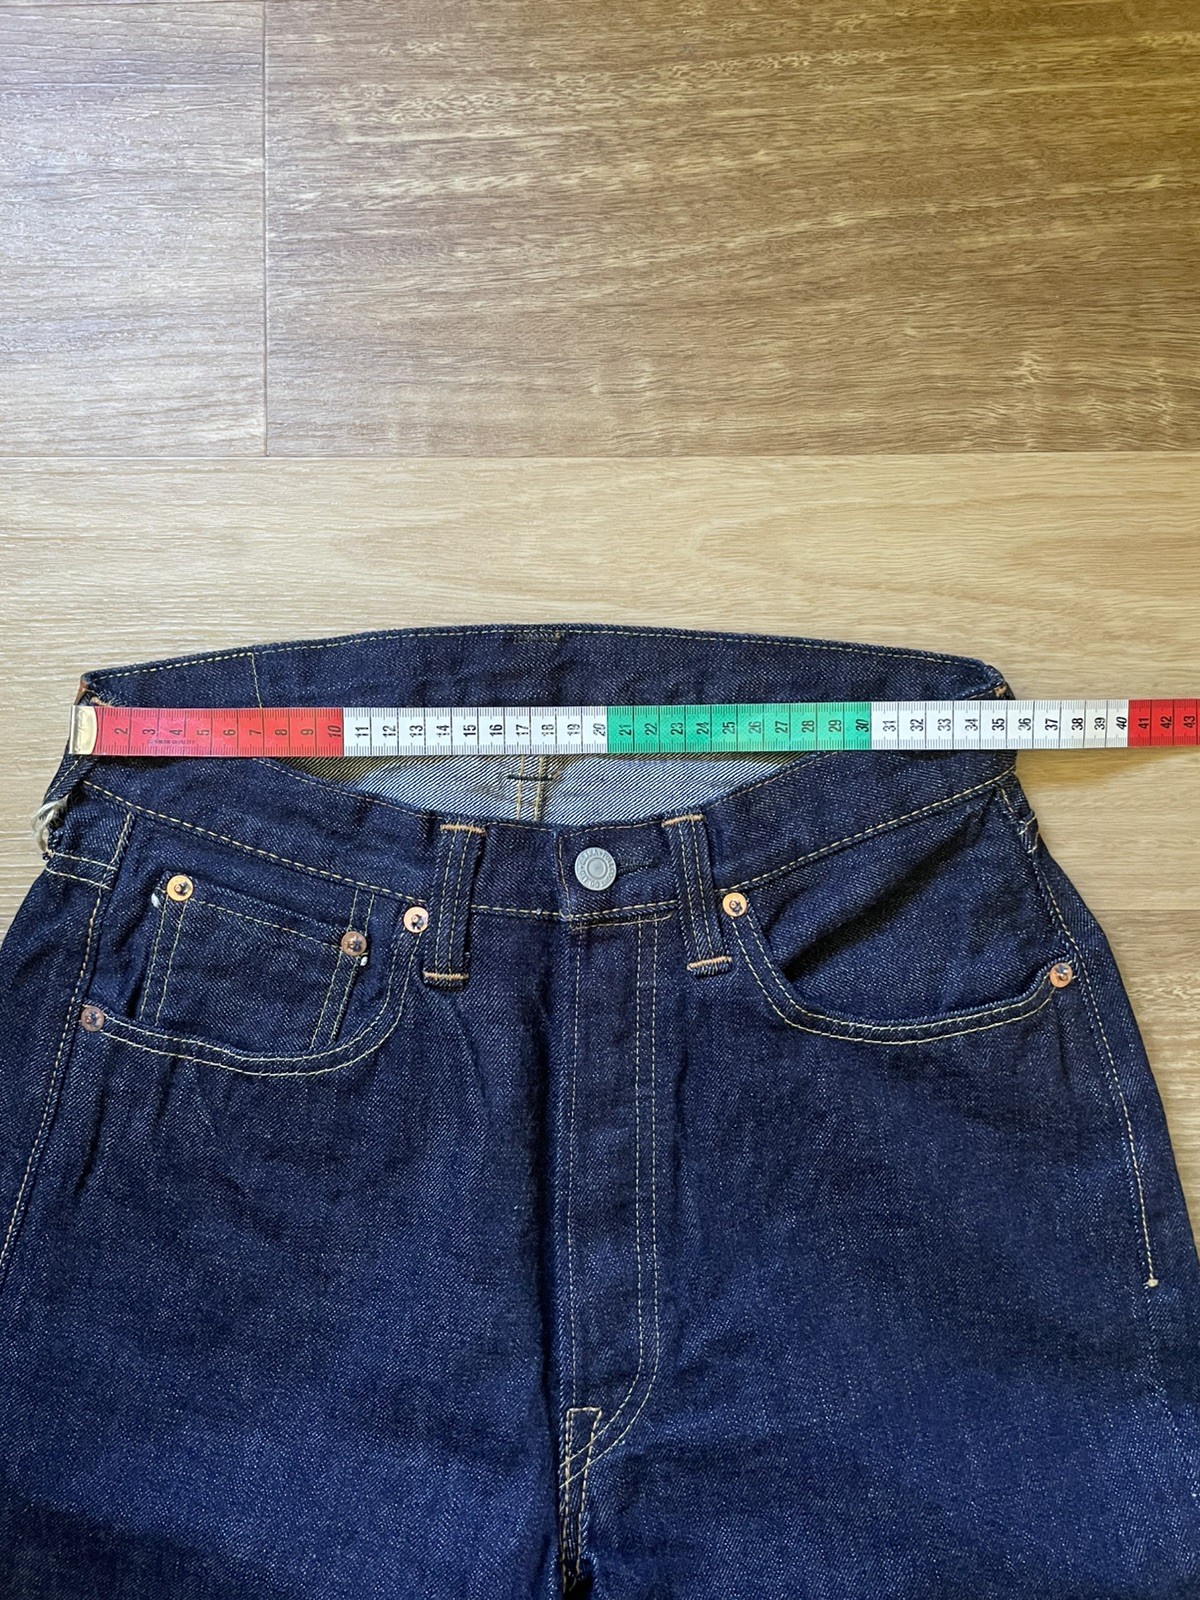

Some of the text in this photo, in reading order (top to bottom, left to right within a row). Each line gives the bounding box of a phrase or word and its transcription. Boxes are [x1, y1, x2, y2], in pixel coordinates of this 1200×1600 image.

[328, 725, 341, 738] 10
[355, 726, 369, 738] 11
[383, 725, 396, 738] 12
[410, 725, 423, 738] 13
[436, 725, 450, 737] 14
[463, 724, 476, 737] 15
[490, 724, 503, 737] 16
[516, 724, 529, 736] 17
[542, 724, 554, 736] 18
[567, 724, 580, 736] 19
[593, 723, 606, 736] 20
[619, 724, 632, 736] 21
[645, 723, 657, 735] 22
[671, 722, 683, 735] 23
[697, 722, 709, 735] 24
[723, 722, 735, 734] 25
[749, 721, 761, 734] 26
[775, 721, 788, 734] 27
[802, 720, 814, 733] 28
[828, 720, 841, 732] 29
[856, 719, 869, 732] 30
[883, 720, 896, 732] 31
[910, 719, 923, 731] 32
[938, 719, 951, 731] 33
[965, 718, 978, 731] 34
[992, 718, 1005, 731] 35
[1019, 718, 1031, 731] 36
[1045, 718, 1058, 731] 37
[1071, 718, 1083, 730] 38
[1094, 717, 1105, 730] 39
[1116, 717, 1127, 729] 40
[1138, 718, 1149, 729] 41
[1160, 716, 1172, 729] 42
[1183, 716, 1195, 728] 43
